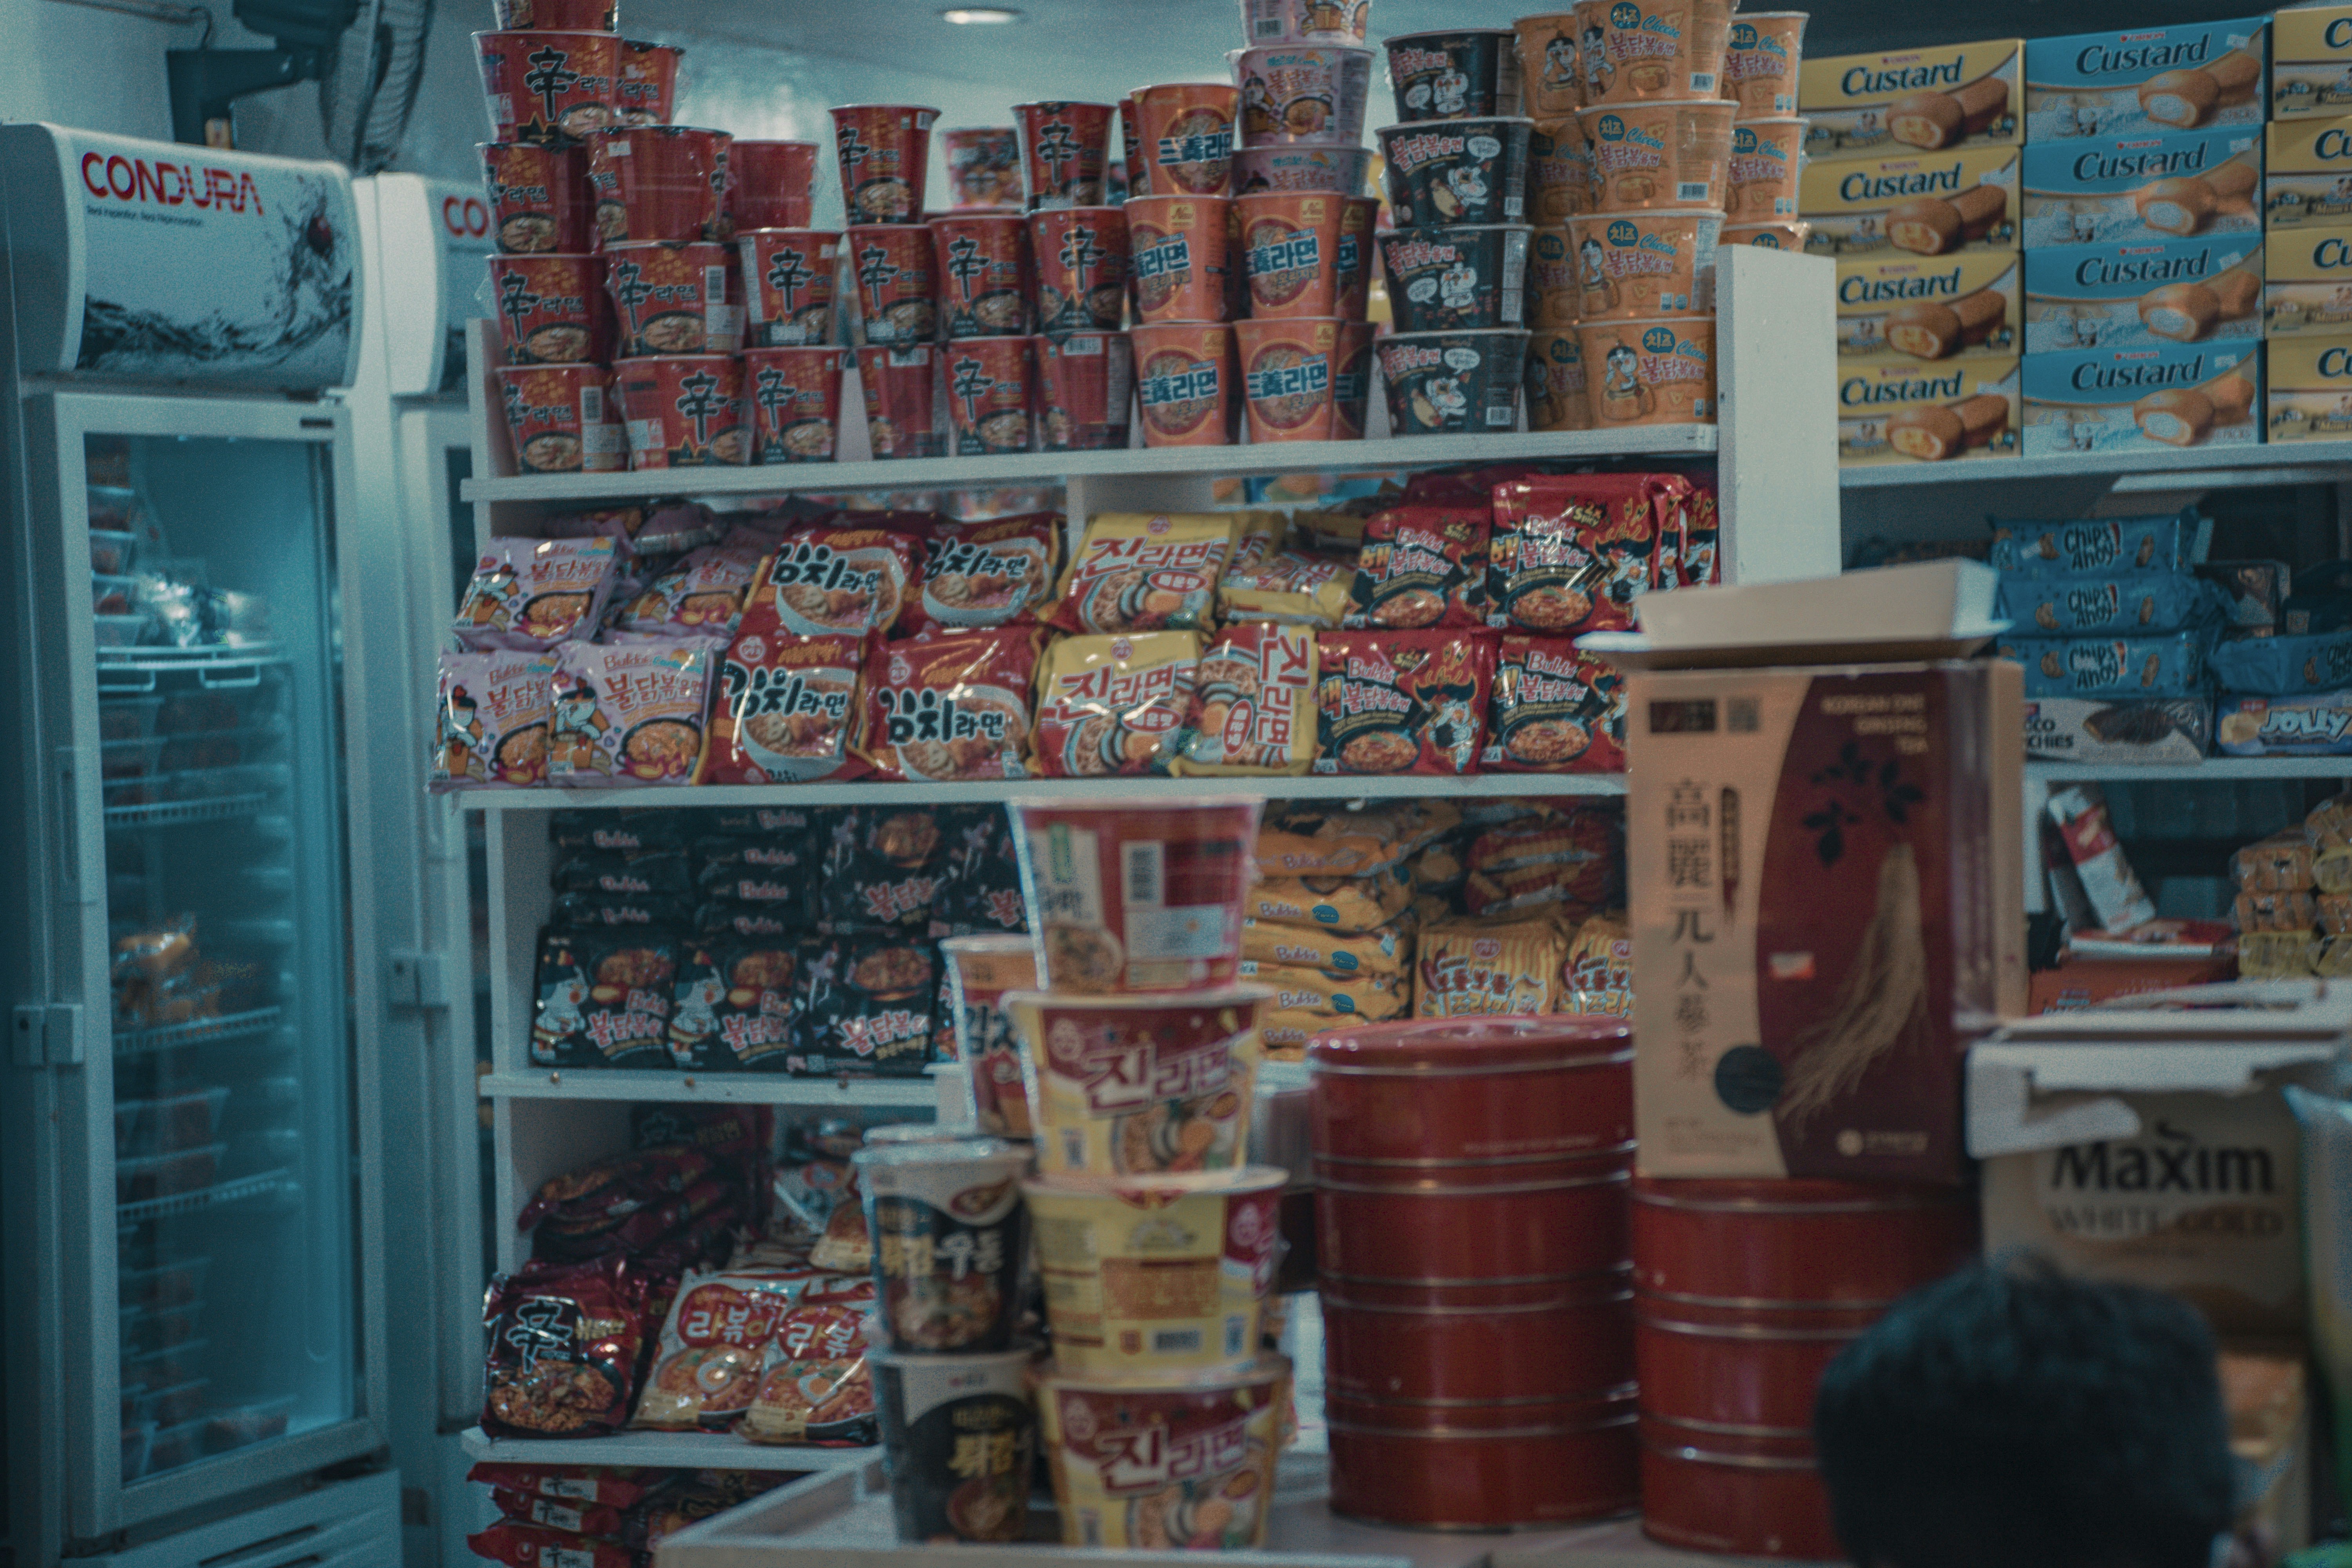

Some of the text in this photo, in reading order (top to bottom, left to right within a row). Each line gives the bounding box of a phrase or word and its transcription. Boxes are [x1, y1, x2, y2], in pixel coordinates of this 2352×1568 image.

[1841, 54, 1964, 96] Custard
[2076, 33, 2212, 75] Custard
[524, 45, 579, 122] 辛
[838, 125, 869, 191] 辛
[1036, 120, 1082, 186] 辛
[1390, 134, 1464, 172] 불닭볶음면
[2073, 141, 2208, 183] Custard
[82, 152, 263, 216] CONDURA
[1839, 162, 1962, 202] Custard
[768, 248, 813, 312] 辛
[860, 243, 899, 311] 辛
[948, 235, 990, 302] 辛
[1059, 225, 1106, 292] 辛
[1838, 267, 1961, 305] Custard
[2075, 247, 2211, 287] Custard
[501, 270, 540, 344] 辛
[617, 260, 653, 334] 辛
[755, 366, 796, 431] 辛
[953, 356, 994, 423] 辛
[1840, 370, 1964, 407] Custard
[2071, 353, 2205, 392] Custard
[676, 370, 729, 445] 辛
[1573, 507, 1600, 528] Spicy
[2064, 524, 2111, 550] Chips
[771, 543, 882, 594] 김치라면
[922, 538, 1028, 583] 김치라면
[1083, 536, 1213, 579] 진라면
[2067, 587, 2108, 612] Chips
[2069, 646, 2115, 670] Chips
[722, 659, 848, 719] 김치라면
[877, 686, 1005, 744] 김치라면
[1055, 664, 1175, 723] 진라면
[2261, 709, 2351, 741] JOLLY
[1082, 1040, 1236, 1120] 진라면
[2051, 1142, 2275, 1194] Maxim
[505, 1300, 573, 1375] 辛
[685, 1305, 779, 1343] 라볶이
[1098, 1416, 1249, 1497] 진라면
